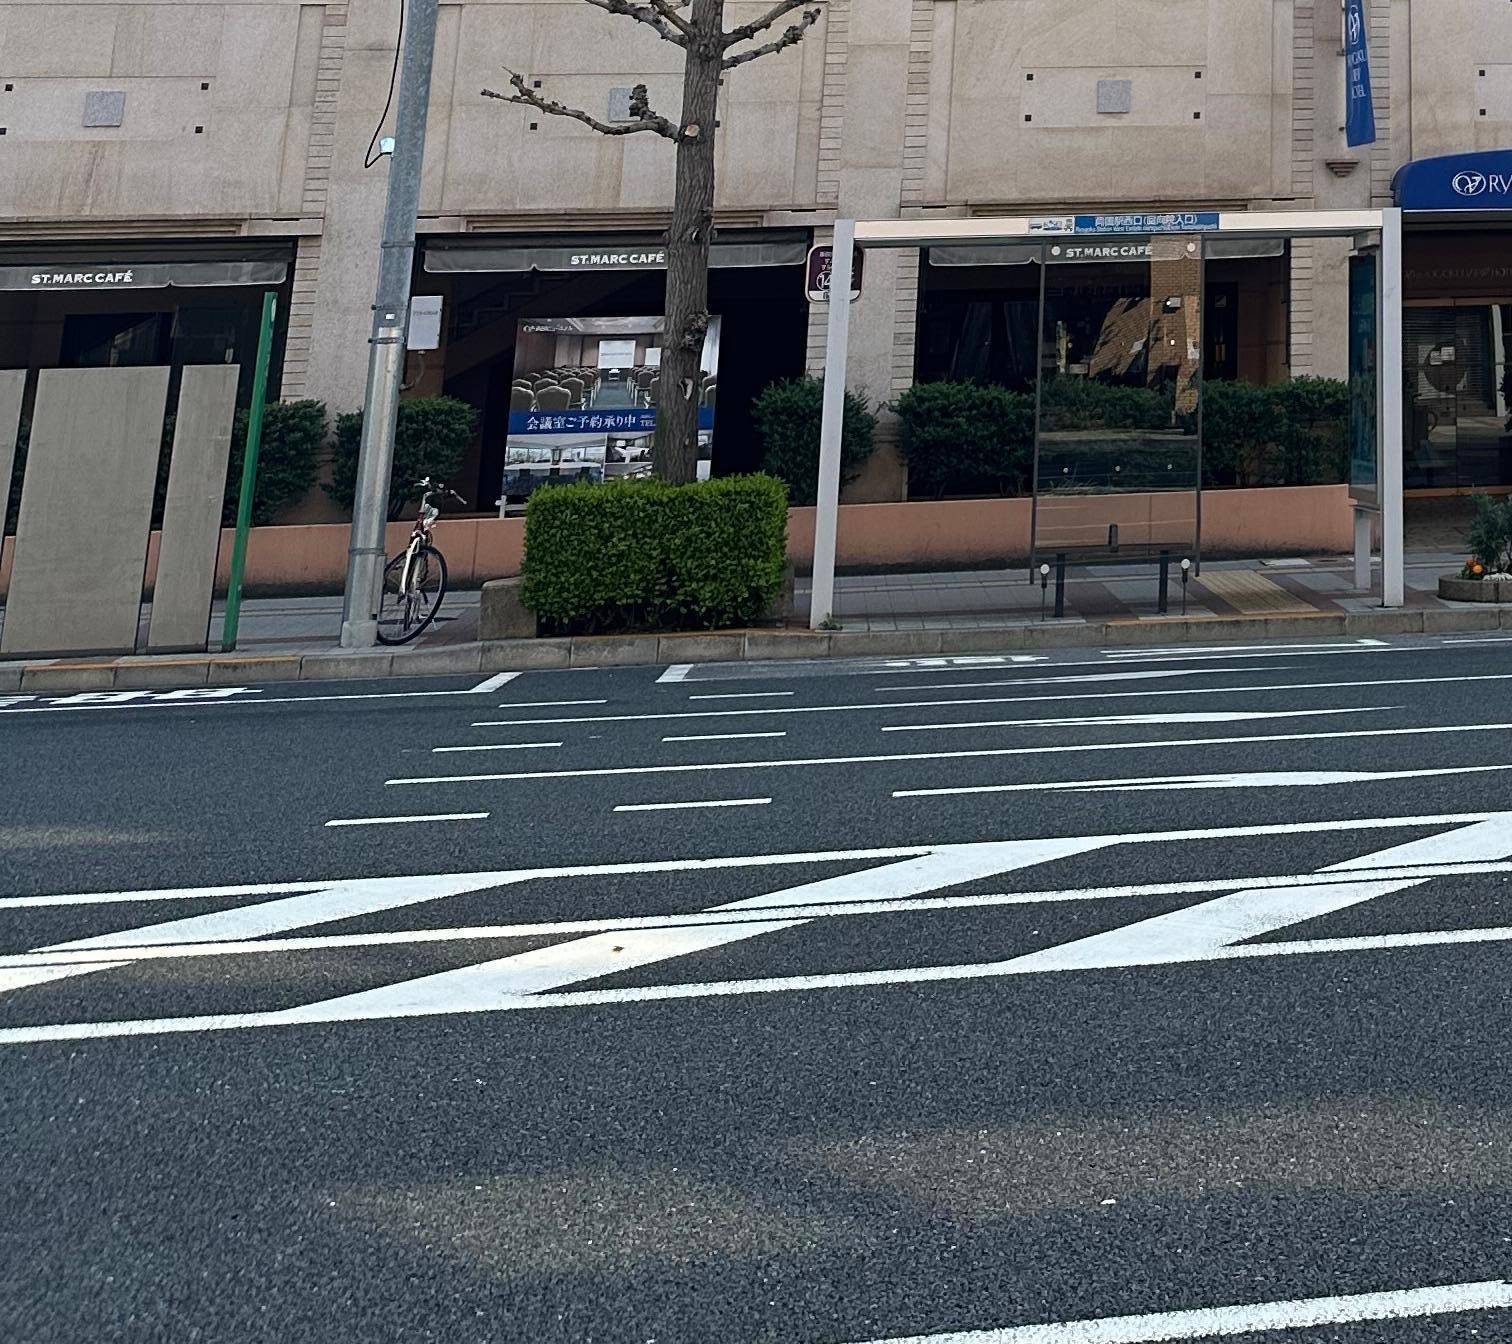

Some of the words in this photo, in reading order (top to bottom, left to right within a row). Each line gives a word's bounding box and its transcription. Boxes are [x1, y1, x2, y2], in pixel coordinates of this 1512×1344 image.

[570, 254, 629, 265] ST.MARC
[629, 250, 665, 264] CAFÉ
[1065, 246, 1119, 258] ST.MARC
[1120, 242, 1154, 256] CAFÉ
[31, 273, 94, 285] ST.MARC
[94, 269, 133, 283] CAFÉ
[527, 414, 636, 430] 会議室ご予約承り中
